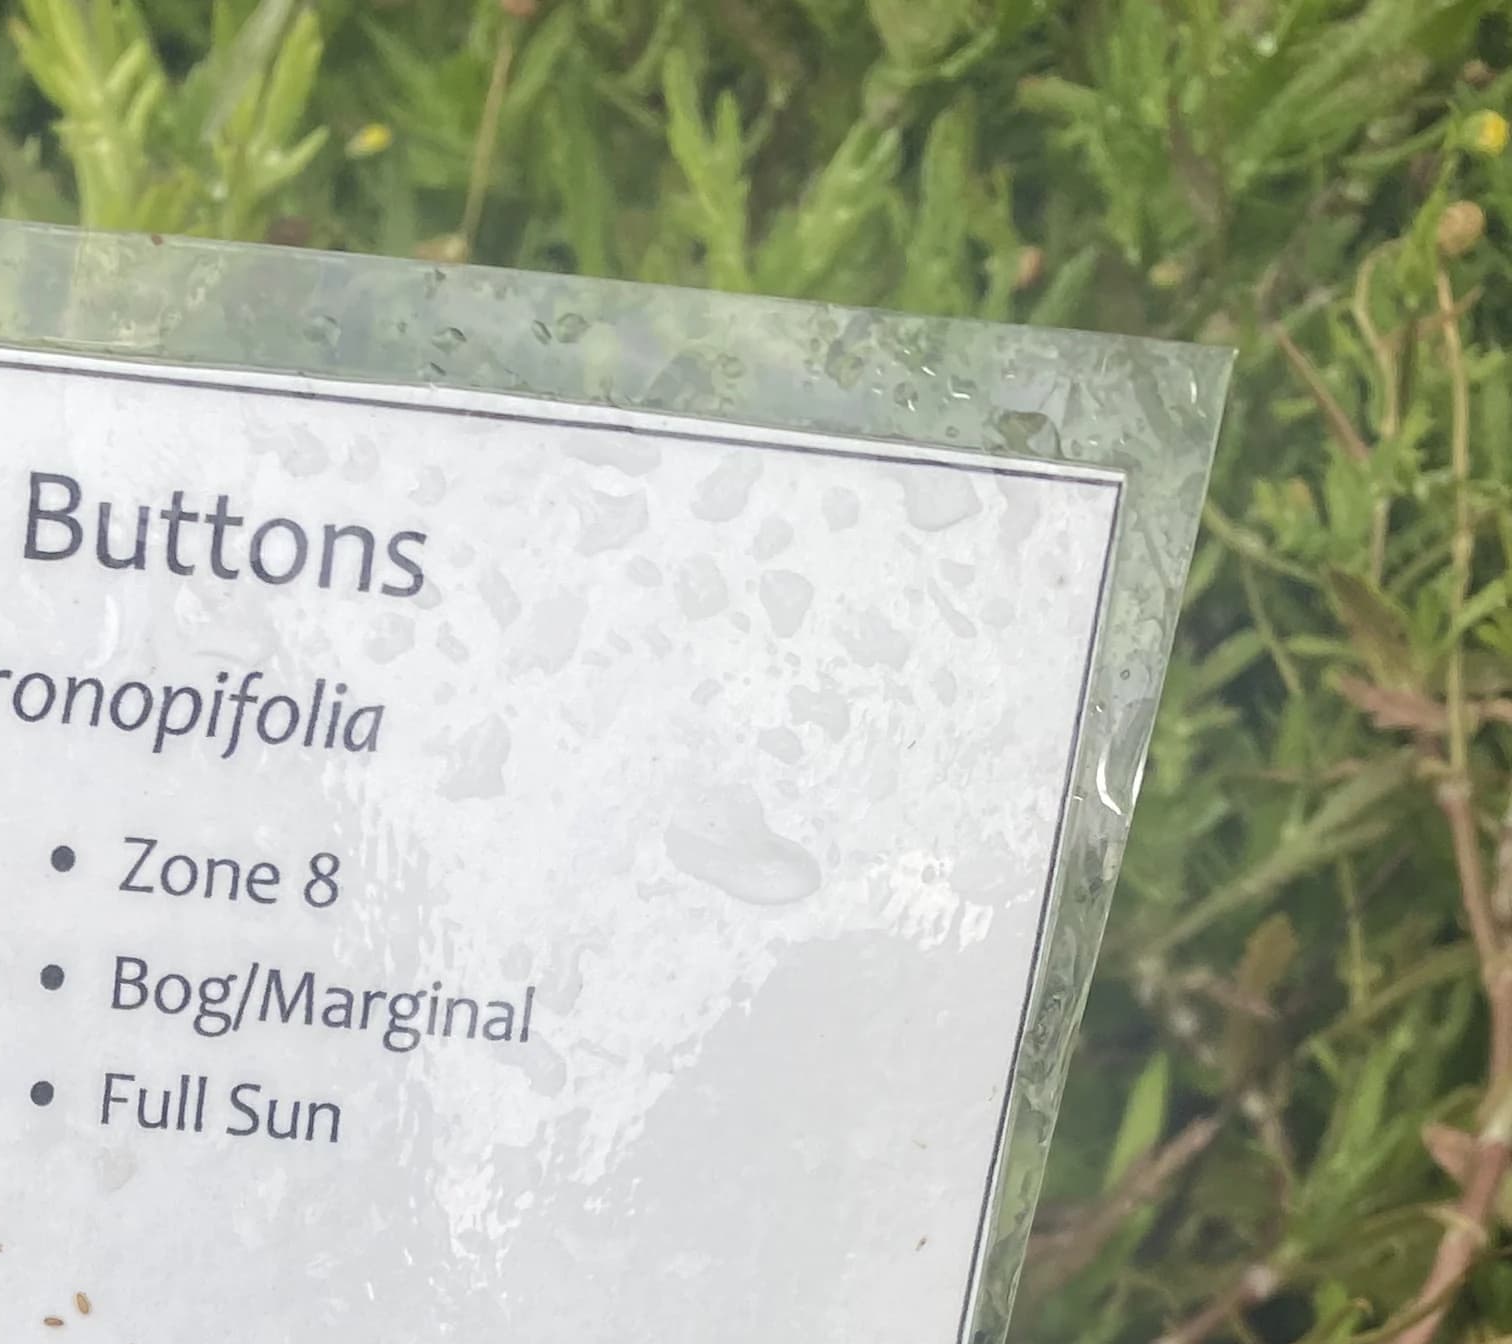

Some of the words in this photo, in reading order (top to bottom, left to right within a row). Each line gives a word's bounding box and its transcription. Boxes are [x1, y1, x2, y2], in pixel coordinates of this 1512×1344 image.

[24, 470, 429, 598] Buttons
[118, 837, 281, 904] Zone
[303, 852, 341, 908] 8
[109, 955, 536, 1052] Bog/Marginal
[99, 1072, 208, 1132] Full
[226, 1082, 342, 1143] Sun
